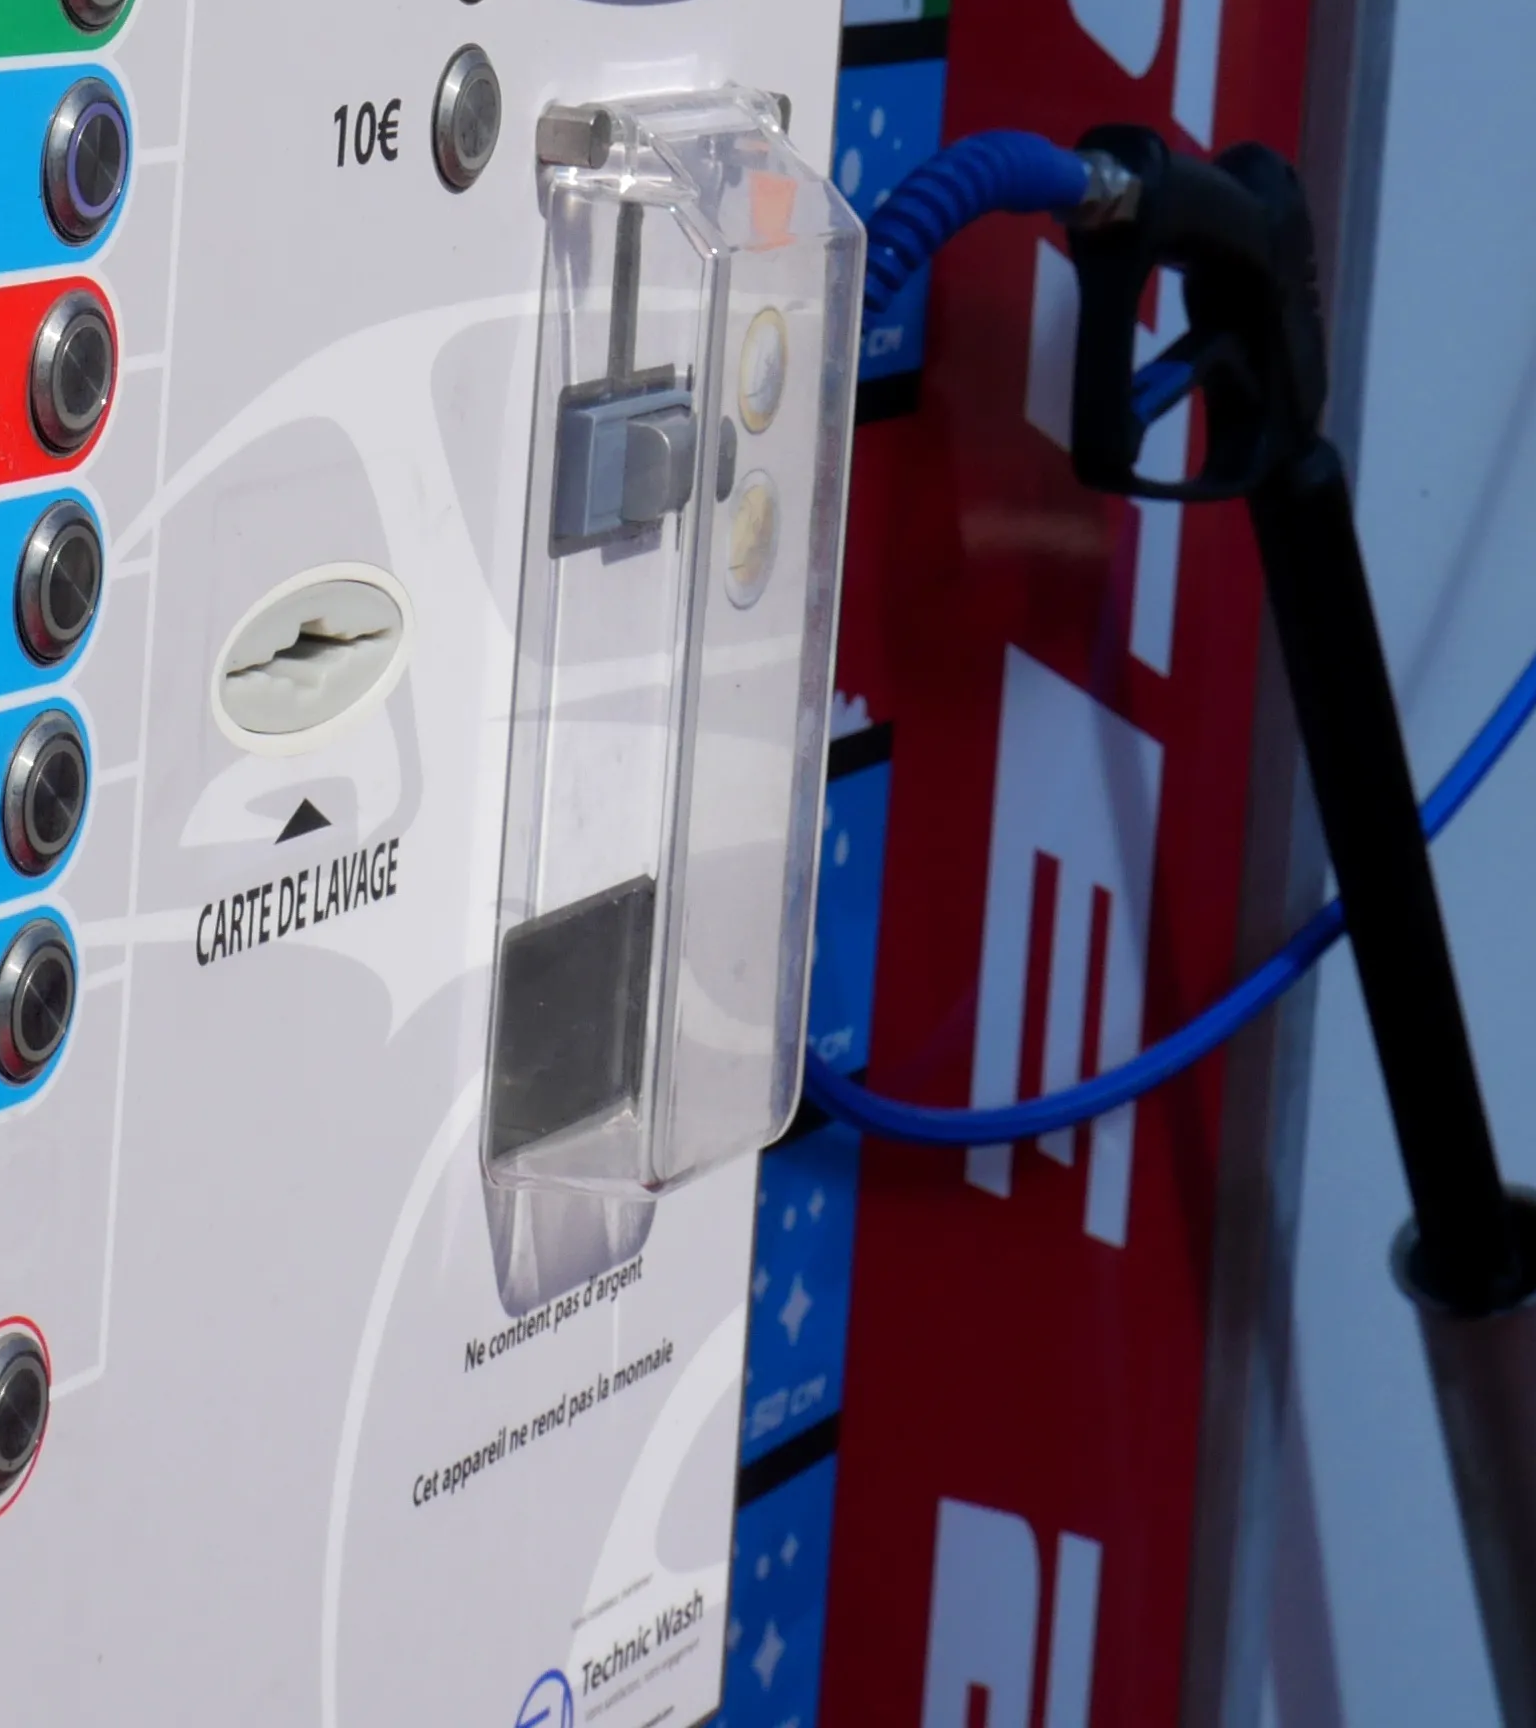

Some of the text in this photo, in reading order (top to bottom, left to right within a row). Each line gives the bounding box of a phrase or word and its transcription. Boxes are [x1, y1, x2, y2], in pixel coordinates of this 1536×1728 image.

[333, 98, 402, 168] 10€
[196, 837, 399, 967] CARTE DE LAVAGE
[464, 1254, 644, 1373] Ne contient pas d'argent
[412, 1337, 675, 1507] Cet appareil ne rend pas la monnaie
[581, 1625, 653, 1698] Technic
[656, 1588, 705, 1647] Wash
